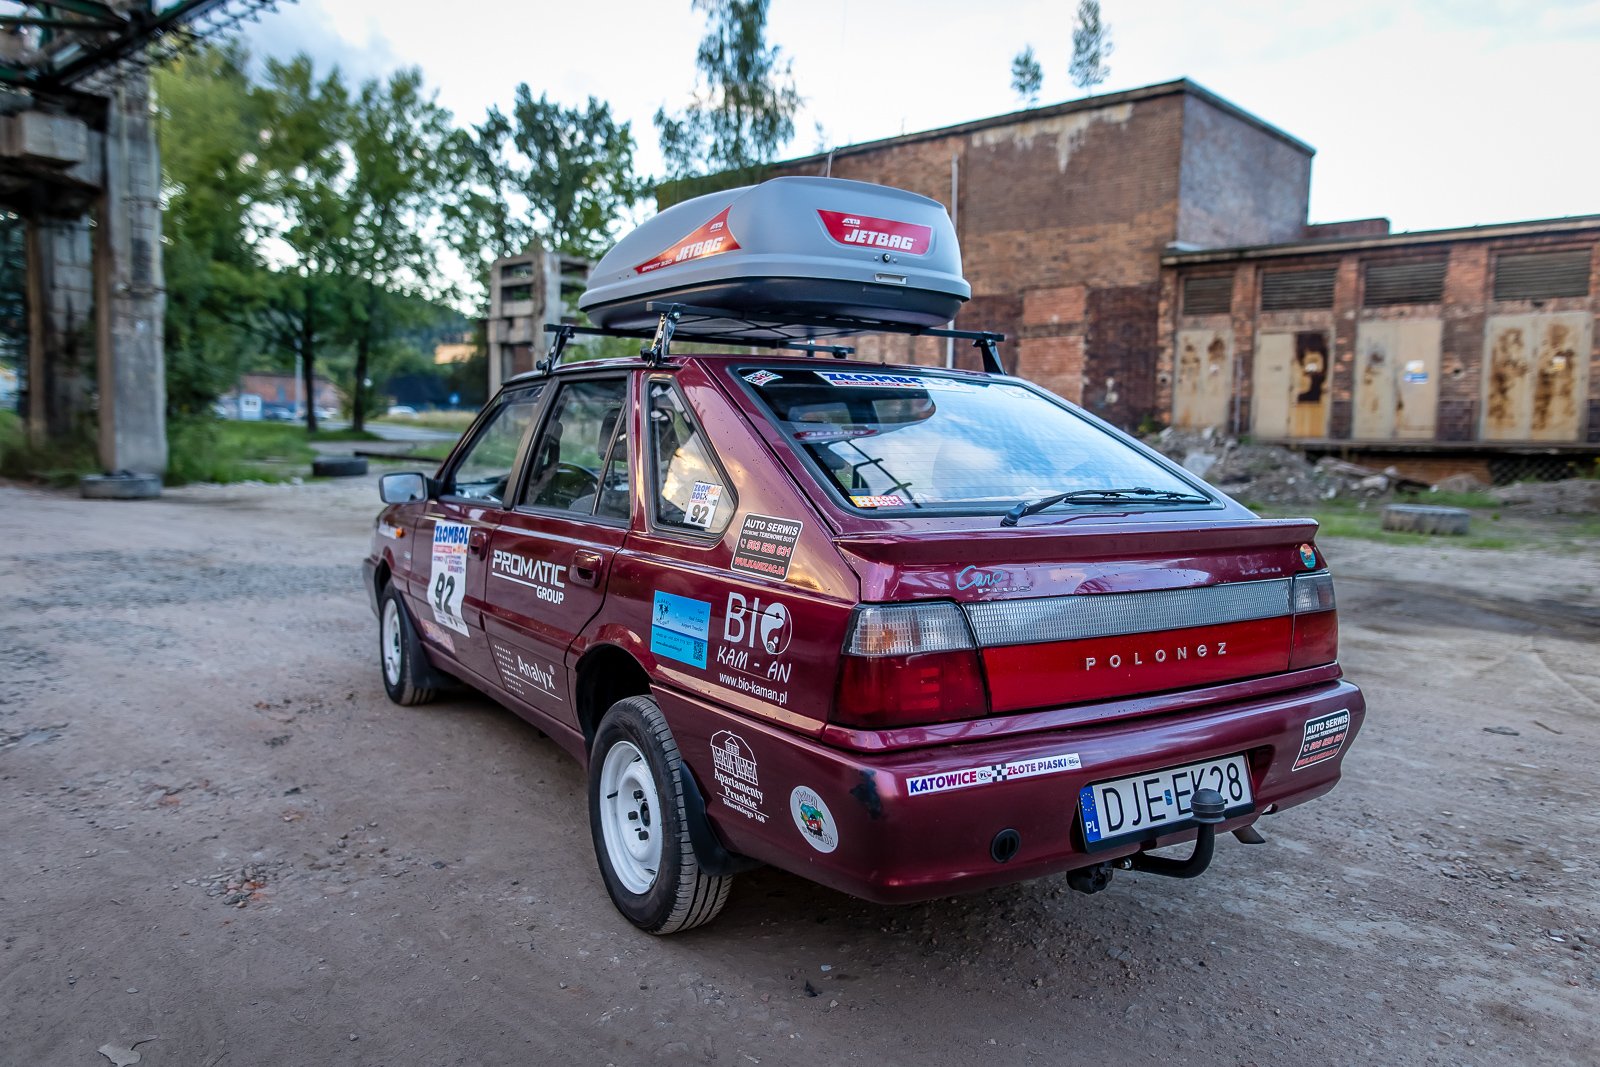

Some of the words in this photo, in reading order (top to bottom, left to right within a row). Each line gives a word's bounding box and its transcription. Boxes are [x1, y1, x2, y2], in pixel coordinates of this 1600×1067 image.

[676, 237, 724, 262] JETBAG
[844, 229, 913, 250] JETBAG
[691, 505, 709, 524] 92
[745, 519, 766, 530] AUTO
[767, 523, 798, 536] SERWIS
[492, 549, 567, 589] PROMATIC
[957, 565, 1004, 590] Caro
[434, 572, 455, 616] 92
[536, 586, 564, 605] GROUP
[517, 655, 556, 690] Analyx
[717, 645, 749, 670] KAM
[767, 660, 792, 684] AN
[719, 672, 788, 705] www.bio-kaman.pl
[1306, 721, 1325, 735] AUTO
[1325, 714, 1348, 729] SERWIS
[714, 768, 763, 804] Apartamenty
[910, 770, 977, 793] KATOWICE
[1007, 763, 1036, 776] ZŁOTE
[1038, 758, 1067, 771] PIASKI
[724, 786, 757, 810] Pruskie
[1102, 778, 1166, 832] DJE
[1085, 821, 1099, 834] PL
